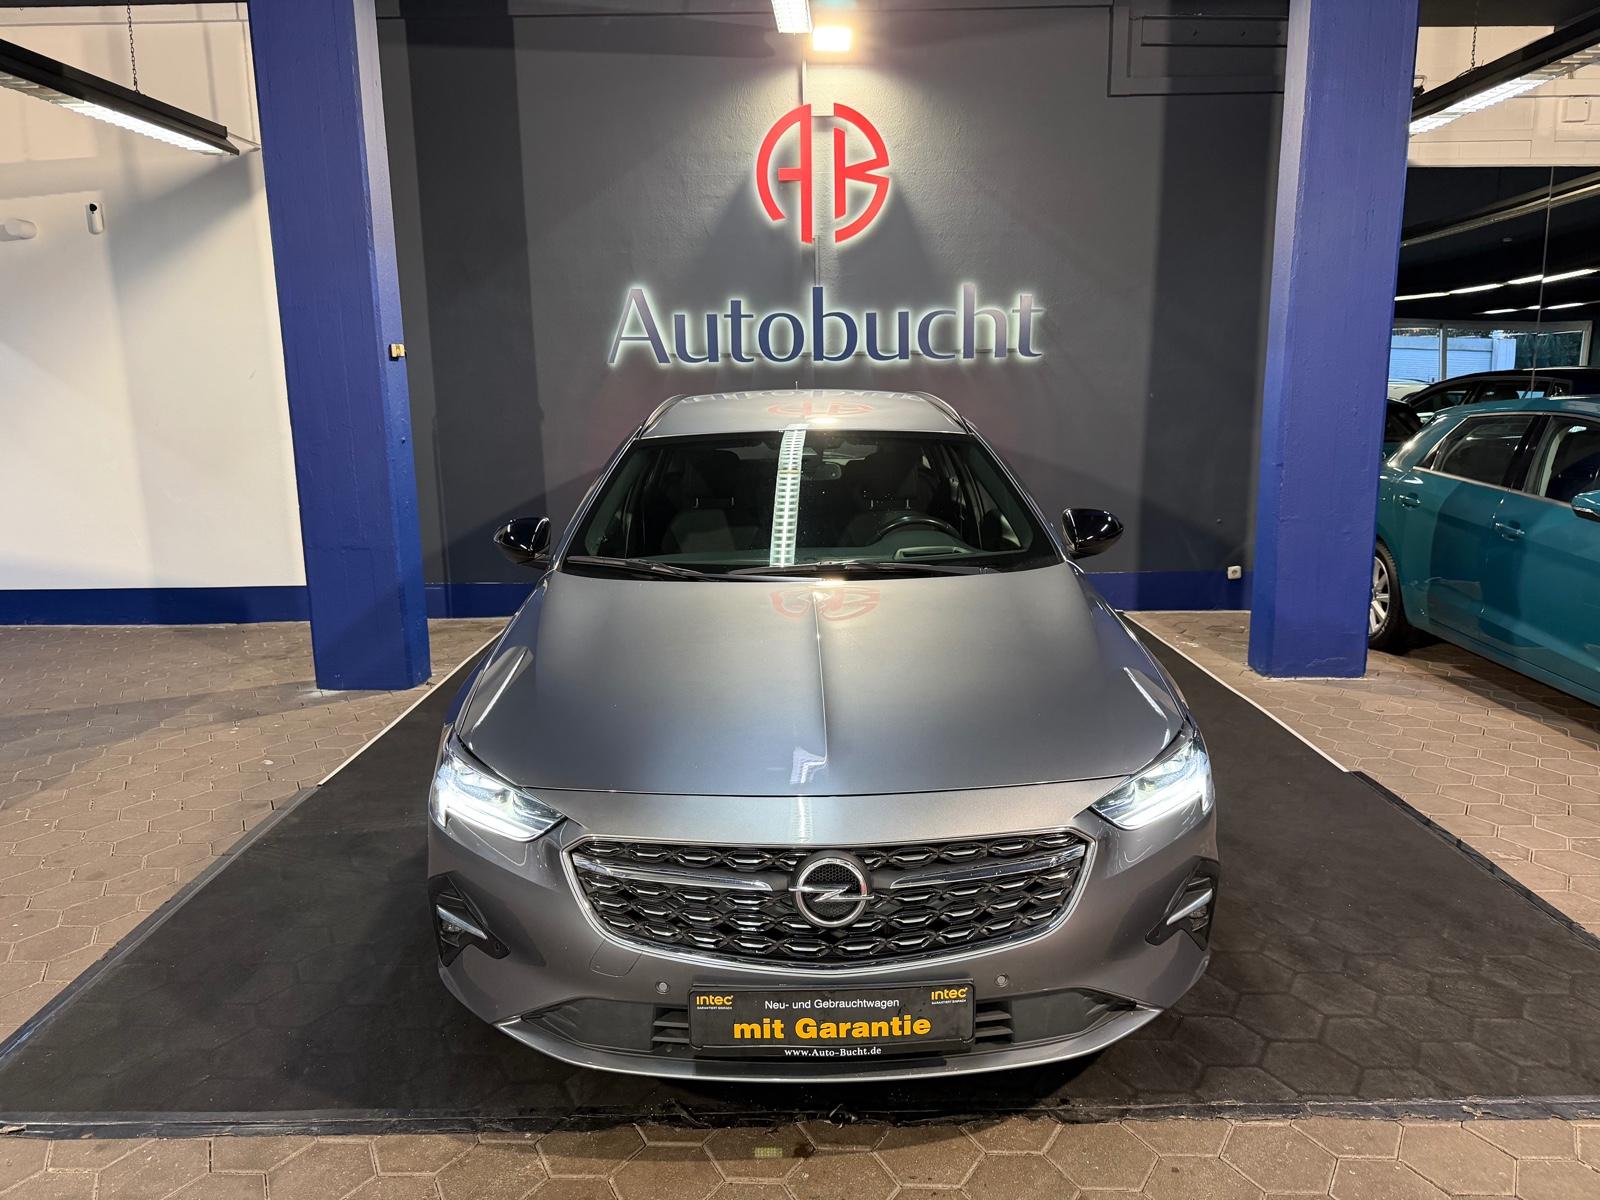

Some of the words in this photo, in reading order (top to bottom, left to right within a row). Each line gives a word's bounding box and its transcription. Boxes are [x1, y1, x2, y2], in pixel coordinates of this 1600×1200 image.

[608, 283, 1045, 364] Autobucht
[764, 1000, 790, 1010] Neu-
[792, 1000, 811, 1010] und
[814, 998, 900, 1010] Gebrauchtwagen
[733, 1018, 785, 1039] mit
[795, 1015, 932, 1039] Garantie
[784, 1046, 882, 1057] www.Auto-Bucht.de
